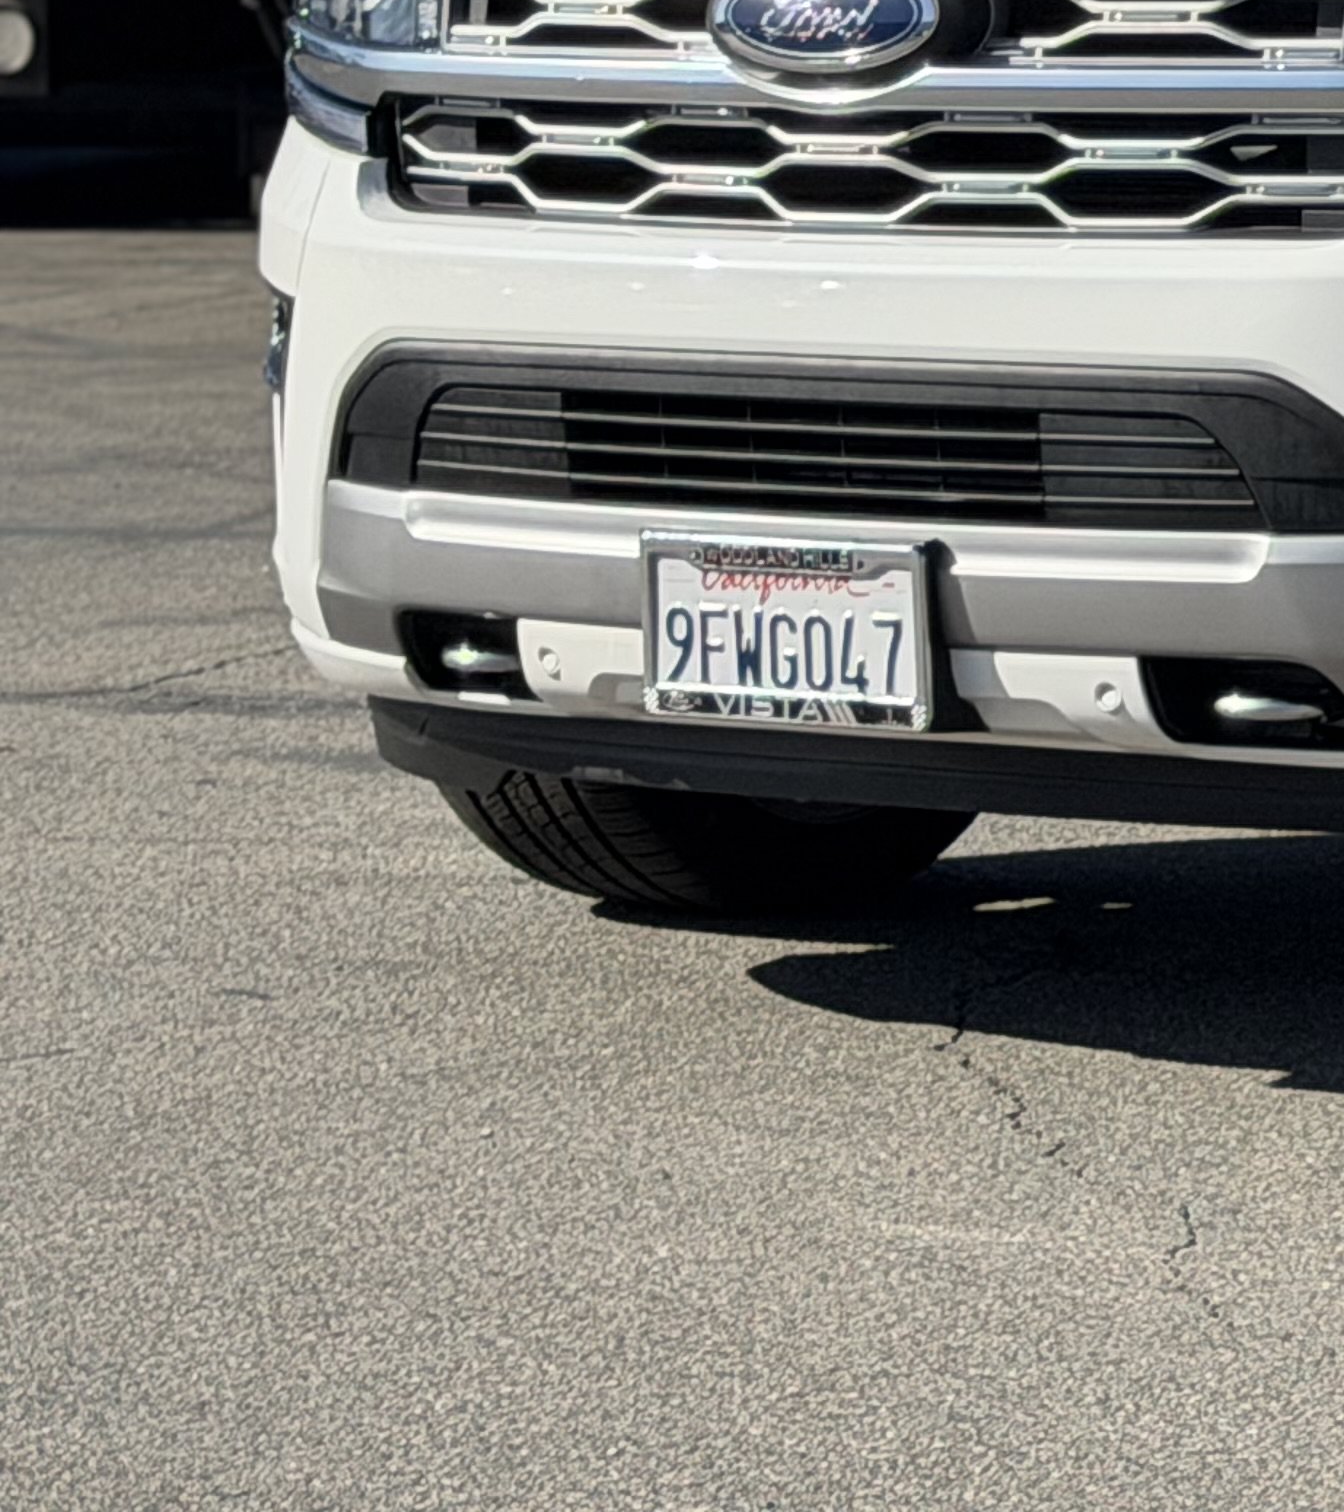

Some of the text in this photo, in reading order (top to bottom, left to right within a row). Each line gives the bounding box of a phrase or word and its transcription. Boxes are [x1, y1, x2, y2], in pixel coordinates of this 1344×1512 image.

[706, 543, 799, 568] WOODLAND
[700, 570, 871, 604] California
[666, 601, 902, 695] 9FWG047
[713, 692, 824, 723] VISTA
